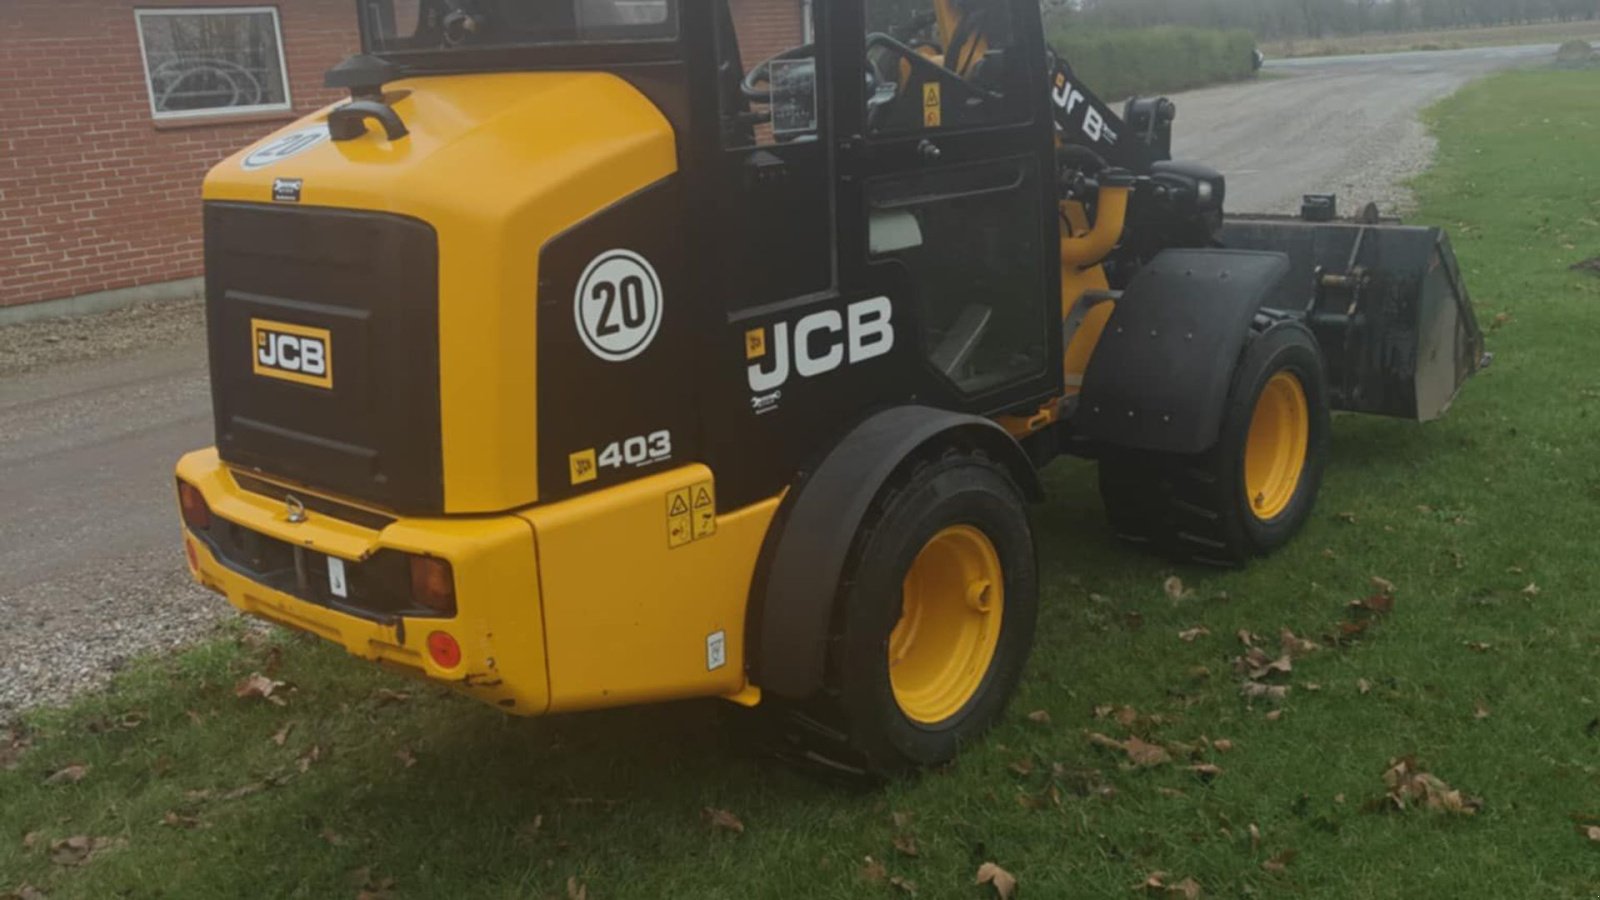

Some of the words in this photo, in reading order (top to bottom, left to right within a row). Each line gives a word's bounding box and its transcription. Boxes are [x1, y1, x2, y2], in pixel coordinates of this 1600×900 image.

[256, 133, 323, 157] 20
[592, 275, 646, 338] 20
[259, 333, 325, 375] JCB
[748, 296, 895, 392] JCB
[598, 429, 671, 468] 403
